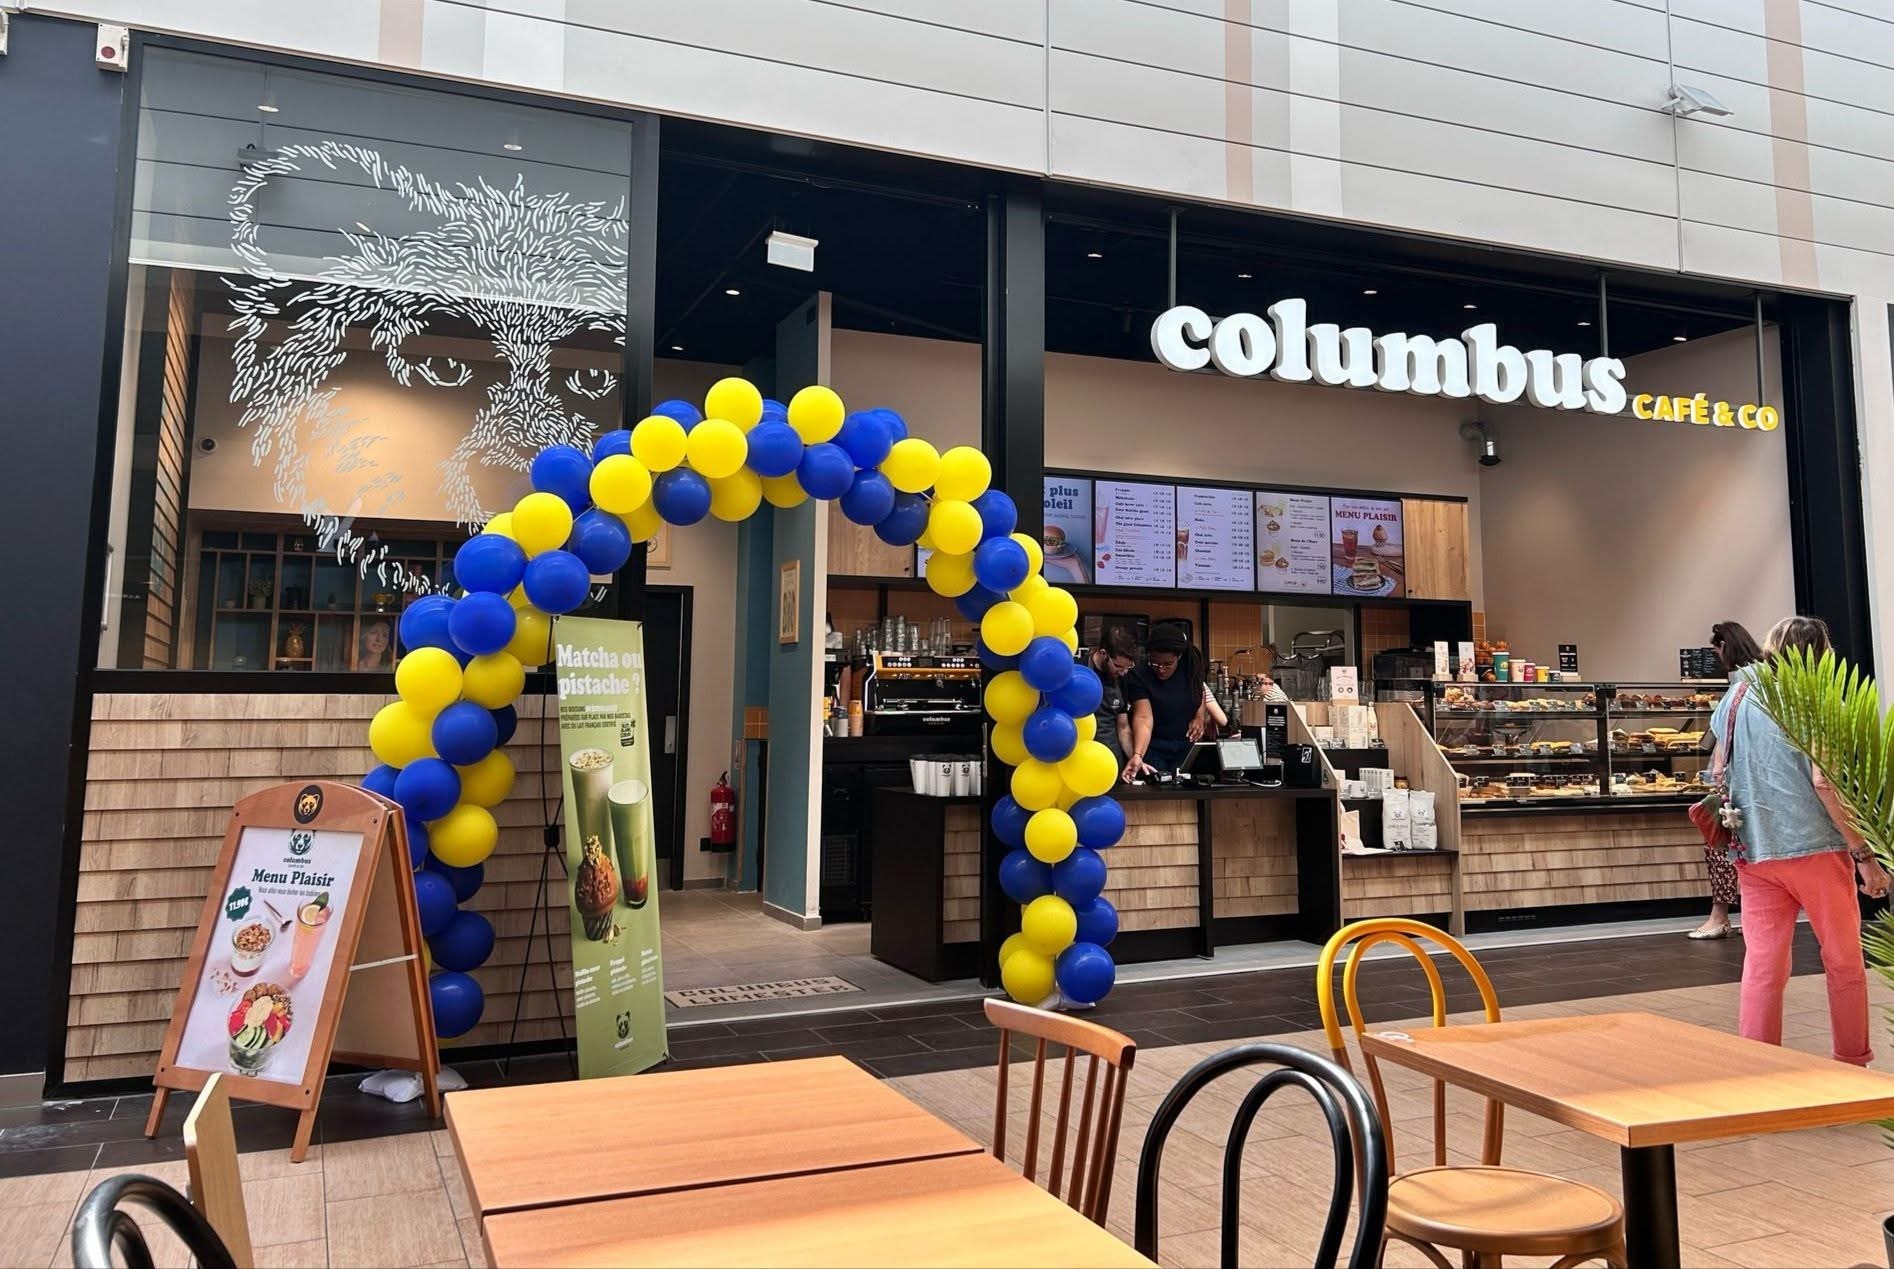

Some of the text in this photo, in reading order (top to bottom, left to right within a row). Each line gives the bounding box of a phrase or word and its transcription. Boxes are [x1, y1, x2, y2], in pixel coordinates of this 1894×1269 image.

[1151, 298, 1779, 432] columbus CAFÉ & CO
[1049, 485, 1079, 497] plus
[1044, 498, 1073, 510] oleil
[1335, 510, 1398, 522] MENU PLAISIR
[557, 643, 642, 668] Matcha ou
[559, 672, 641, 700] pistache ?
[283, 857, 312, 865] columbus
[251, 868, 335, 887] Menu Plaisir
[678, 978, 831, 997] COLUMBUS
